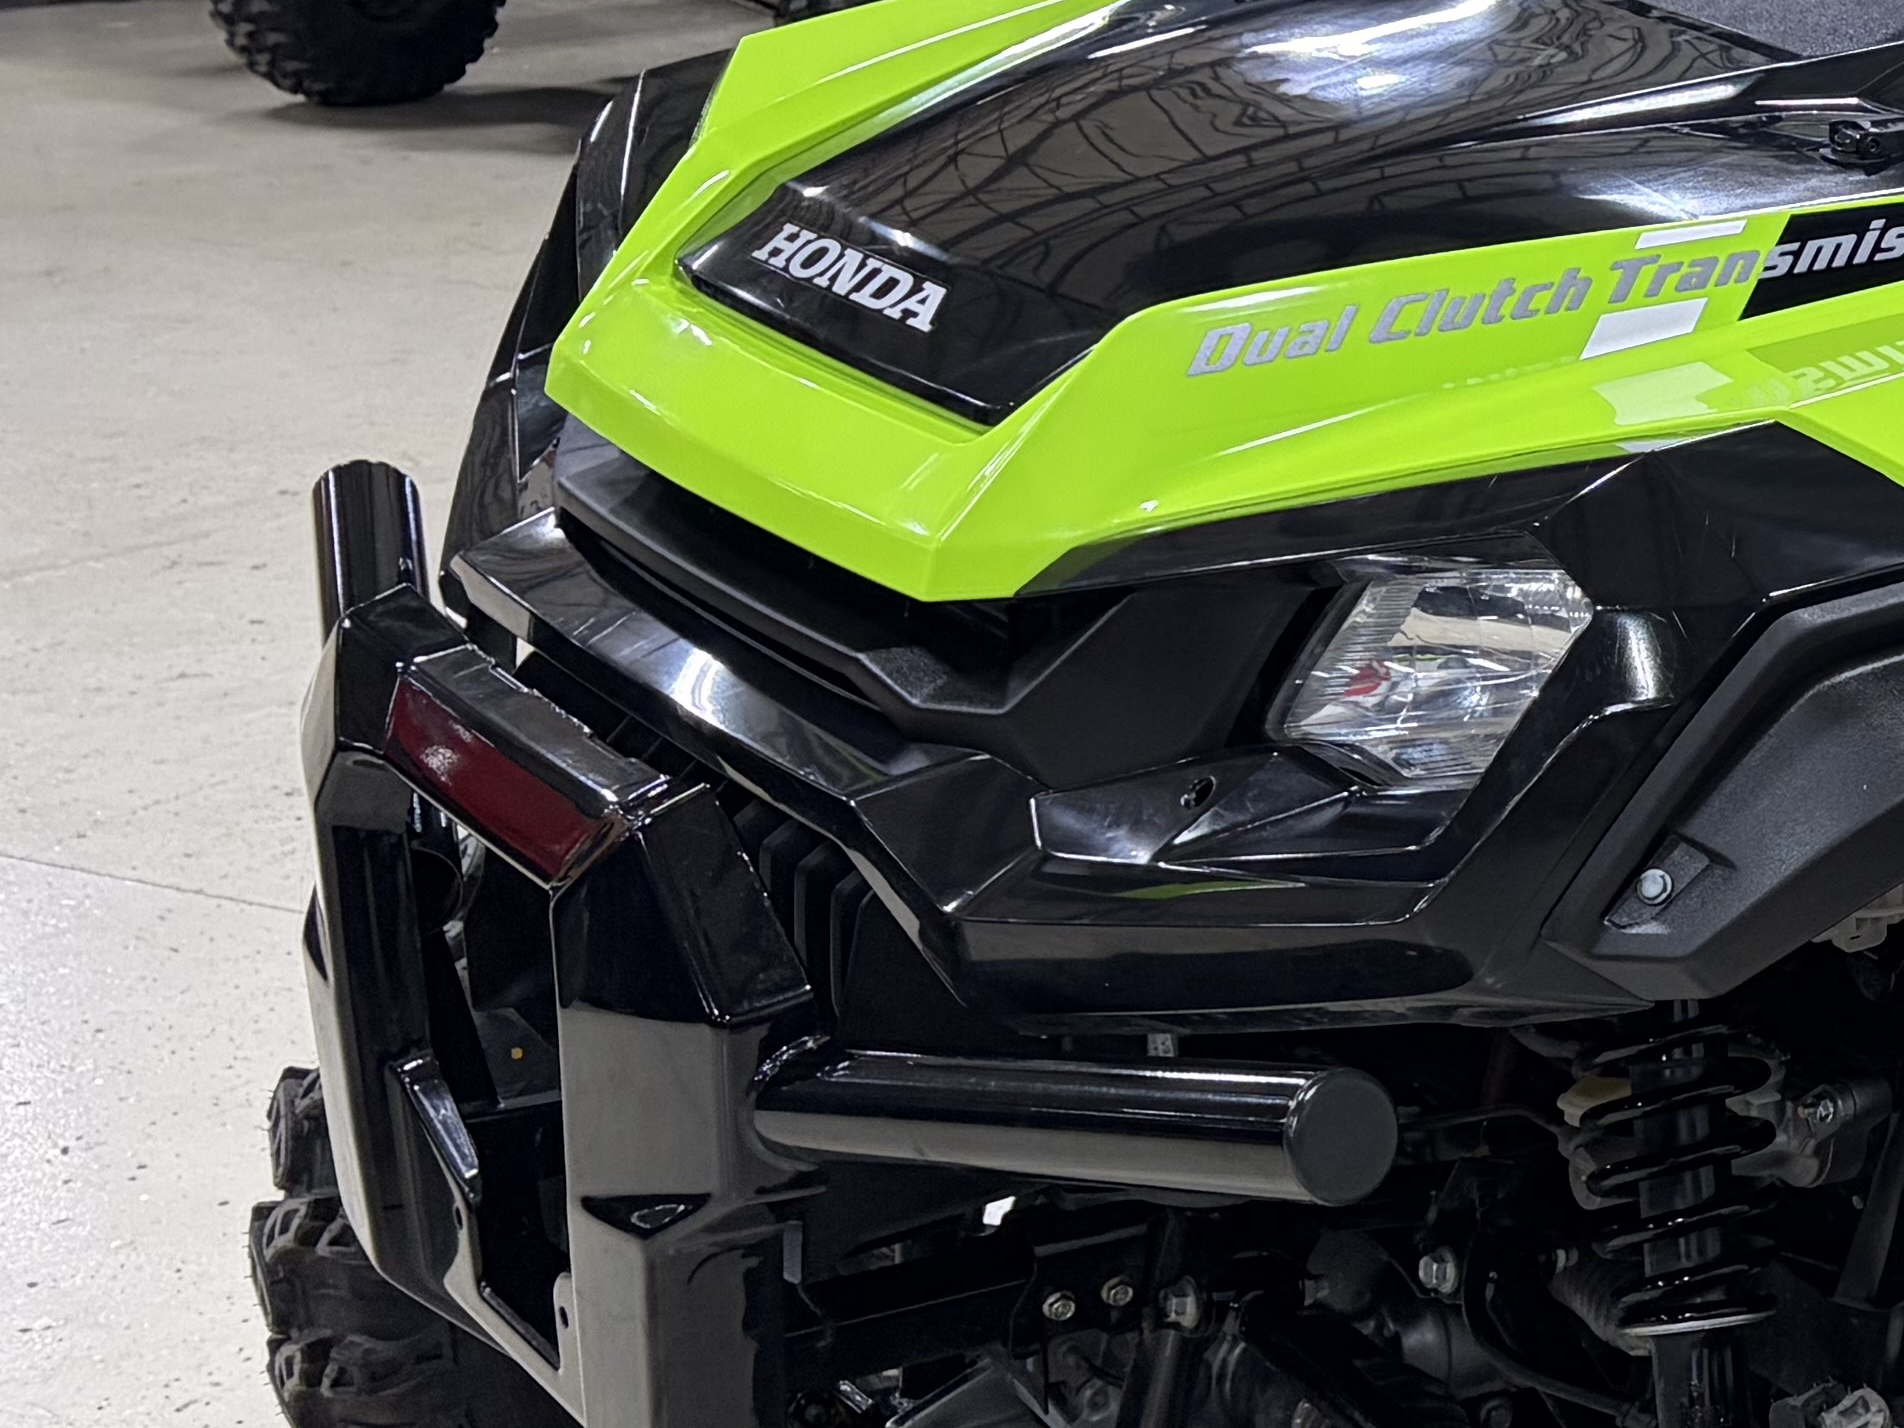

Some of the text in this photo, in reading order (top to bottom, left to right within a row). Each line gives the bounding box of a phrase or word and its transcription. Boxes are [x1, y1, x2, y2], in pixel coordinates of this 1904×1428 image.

[752, 222, 947, 332] HONDA
[1187, 305, 1357, 376] Dual
[1368, 267, 1592, 343] Clutch
